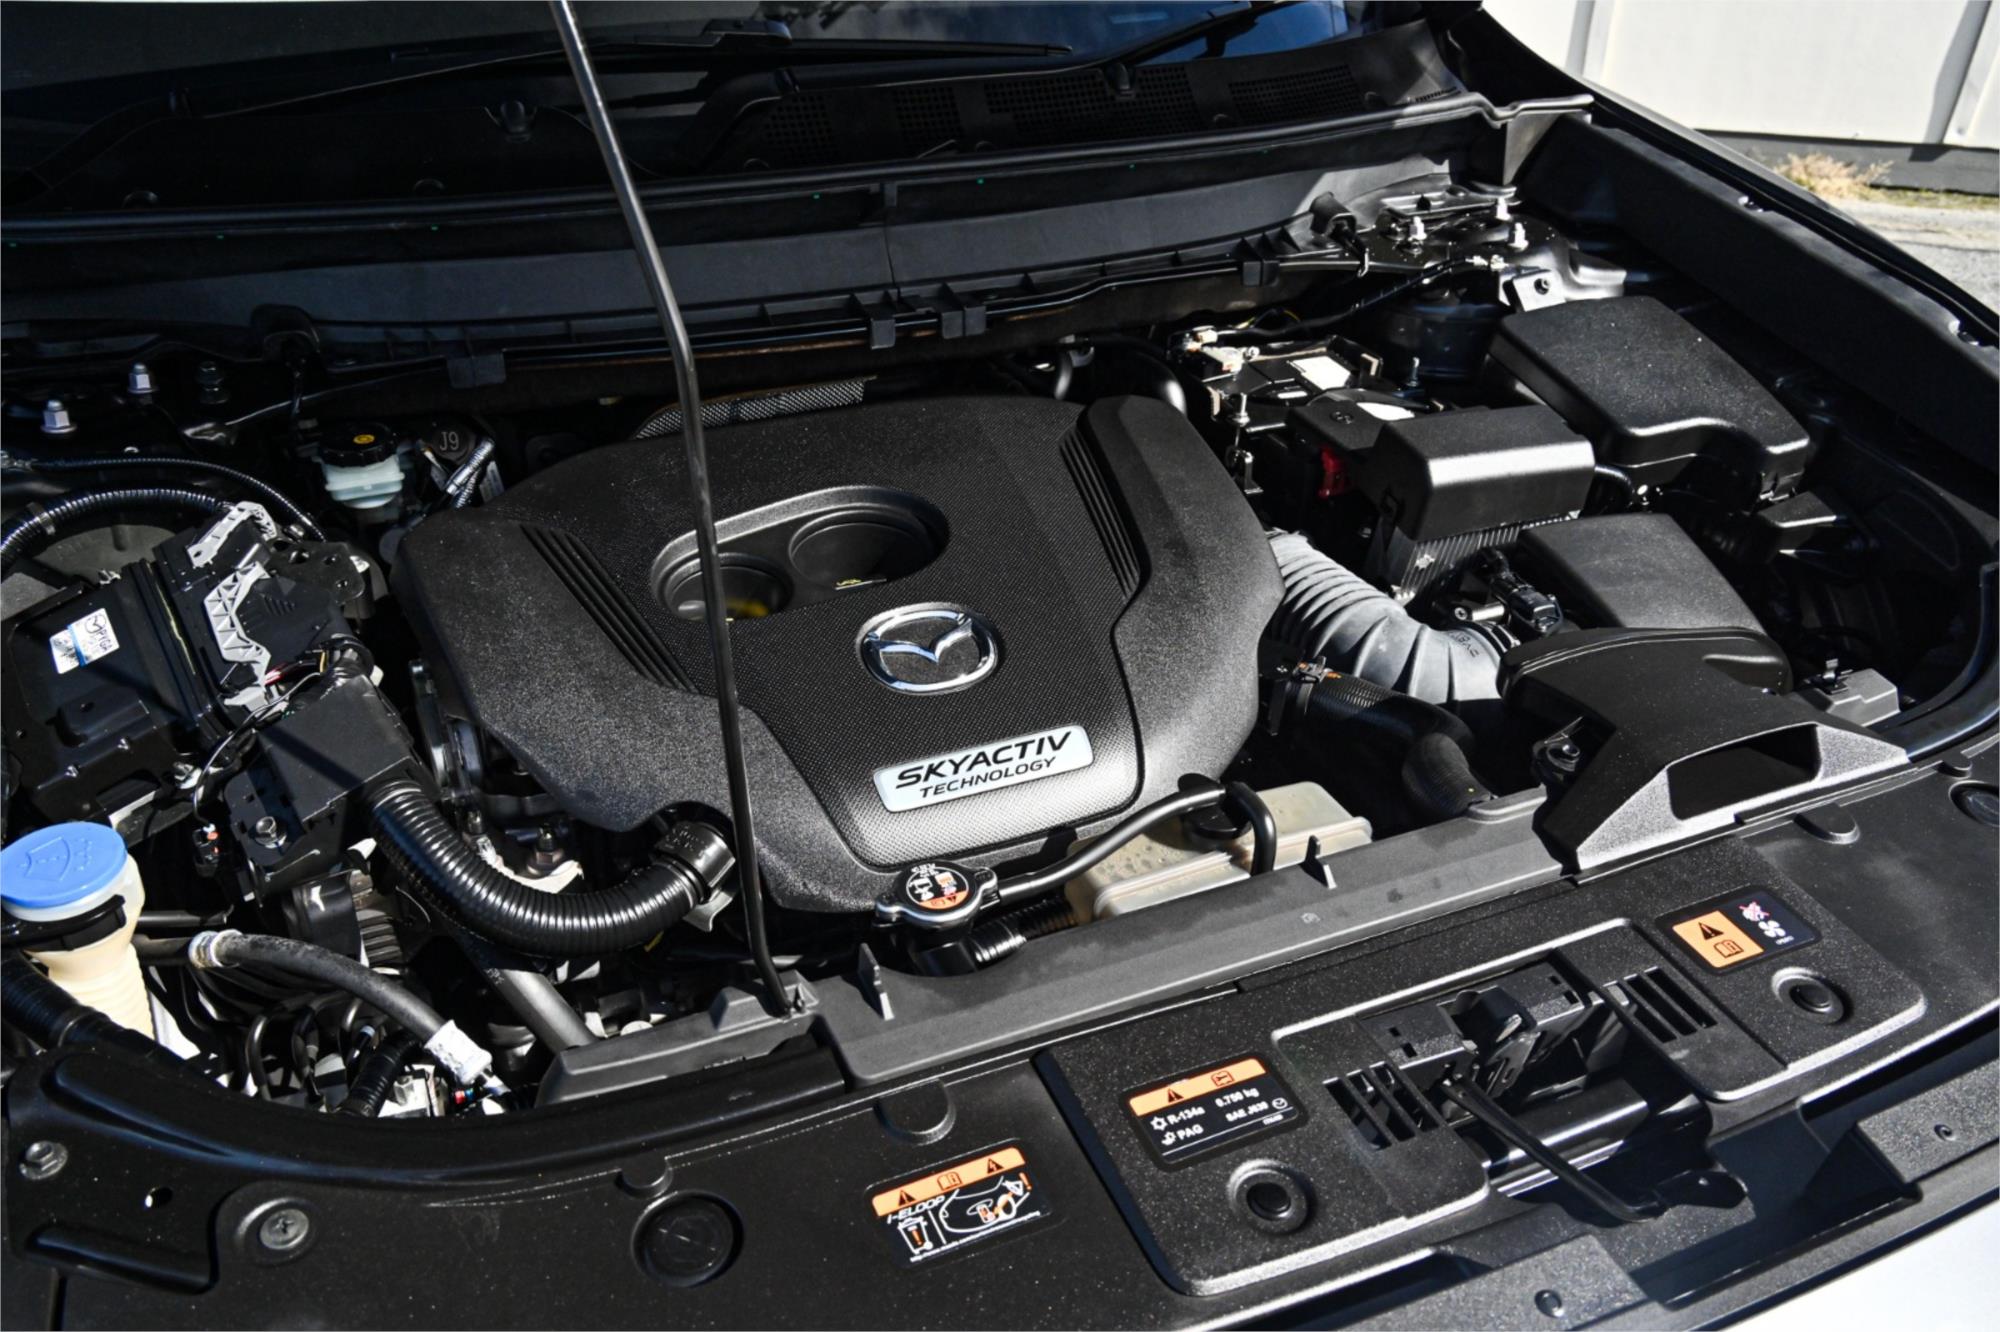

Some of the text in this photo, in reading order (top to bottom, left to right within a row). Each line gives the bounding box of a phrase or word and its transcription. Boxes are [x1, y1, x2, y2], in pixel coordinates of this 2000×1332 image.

[439, 431, 460, 451] J9
[896, 731, 1072, 789] SKYACTIV
[920, 756, 1056, 798] TECHNOLOGY
[1166, 1106, 1206, 1125] R-134a
[1243, 1088, 1260, 1098] kg
[1176, 1124, 1204, 1141] PAG
